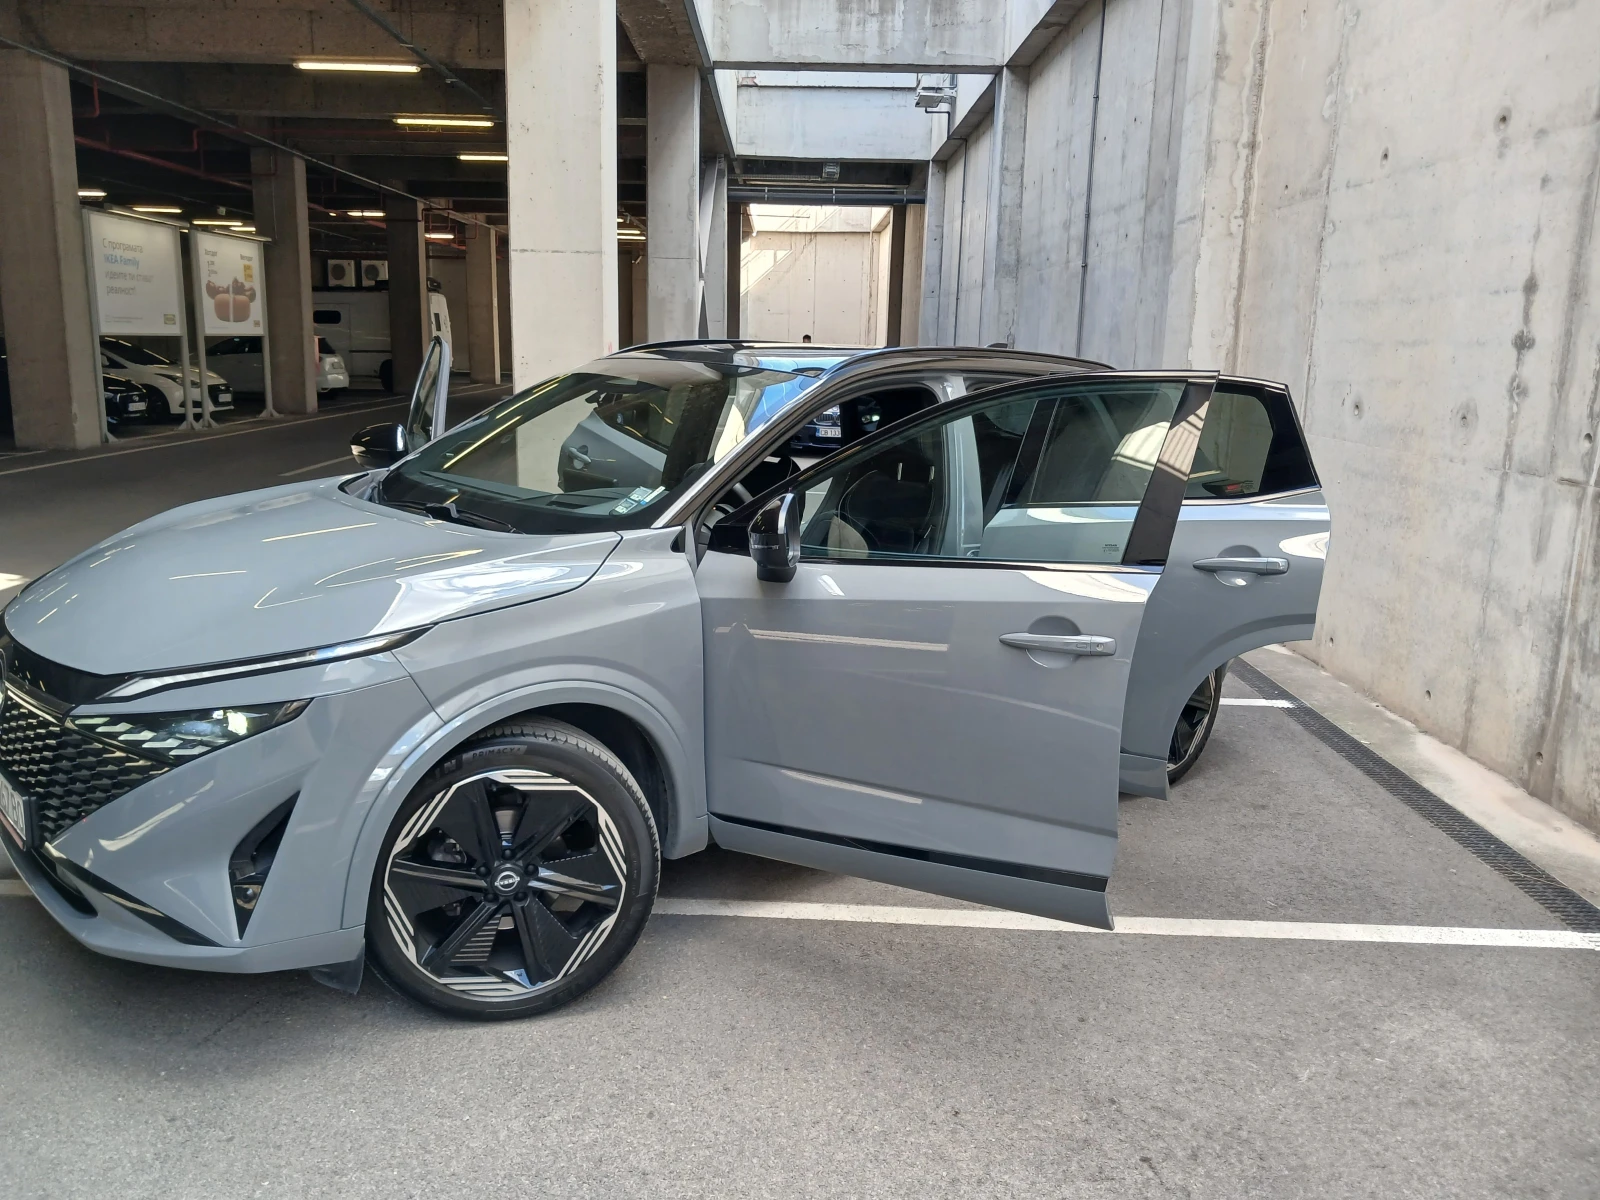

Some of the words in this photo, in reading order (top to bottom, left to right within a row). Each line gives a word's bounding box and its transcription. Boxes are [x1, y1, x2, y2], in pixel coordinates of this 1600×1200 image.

[104, 253, 119, 264] IKEA
[119, 255, 140, 270] Family
[472, 747, 515, 759] PRIMACY
